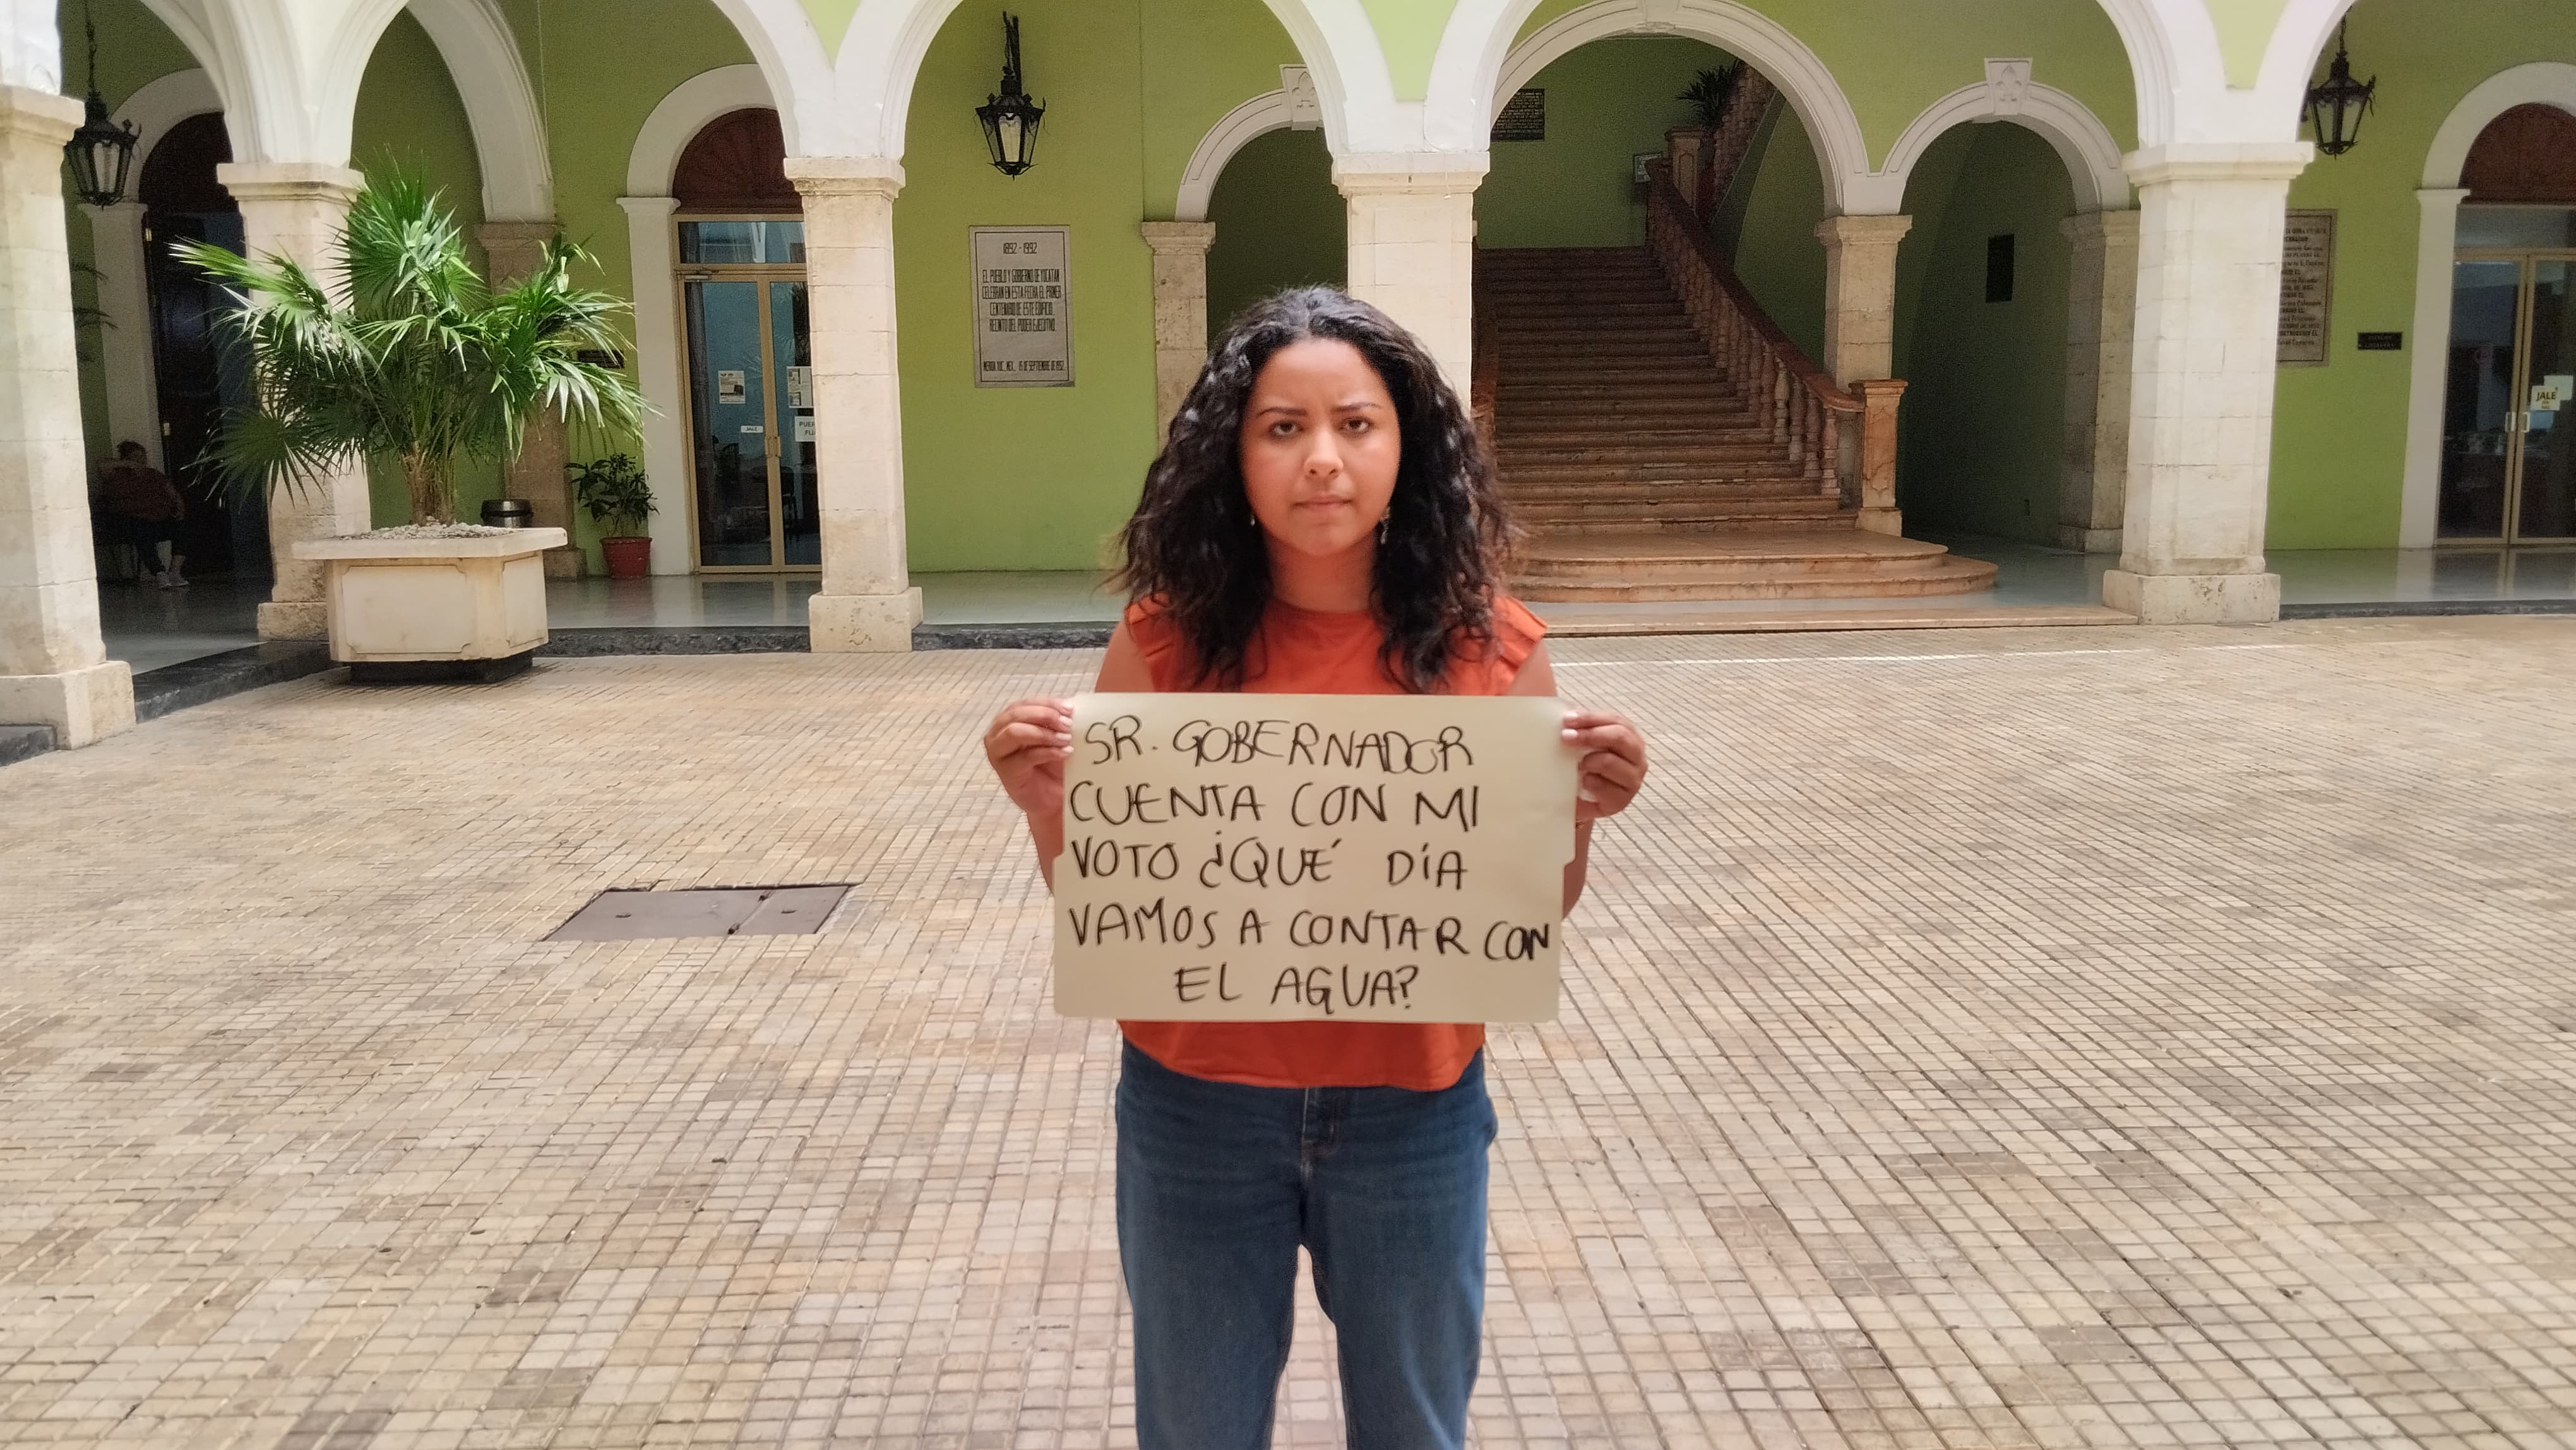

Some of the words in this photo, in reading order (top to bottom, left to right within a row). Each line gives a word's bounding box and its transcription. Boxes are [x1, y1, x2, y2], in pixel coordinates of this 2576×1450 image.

[1003, 242, 1017, 254] 1892
[1023, 242, 1037, 254] 1992
[2536, 392, 2556, 402] JALE
[1085, 714, 1158, 765] SR.
[1172, 719, 1474, 774] GOBERNADOR
[1070, 780, 1266, 825] CUENTA
[1292, 781, 1388, 827] CON
[1416, 785, 1480, 833] MI
[1071, 836, 1180, 880] VOTO
[1199, 830, 1342, 888] ¿QUÉ
[1387, 842, 1468, 890] DÍA
[1068, 896, 1219, 949] VAMOS
[1239, 909, 1270, 945] A
[1290, 909, 1470, 955] CONTAR
[1484, 920, 1551, 962] CON
[1174, 962, 1243, 1004] EL
[1270, 965, 1419, 1015] AGUA?
